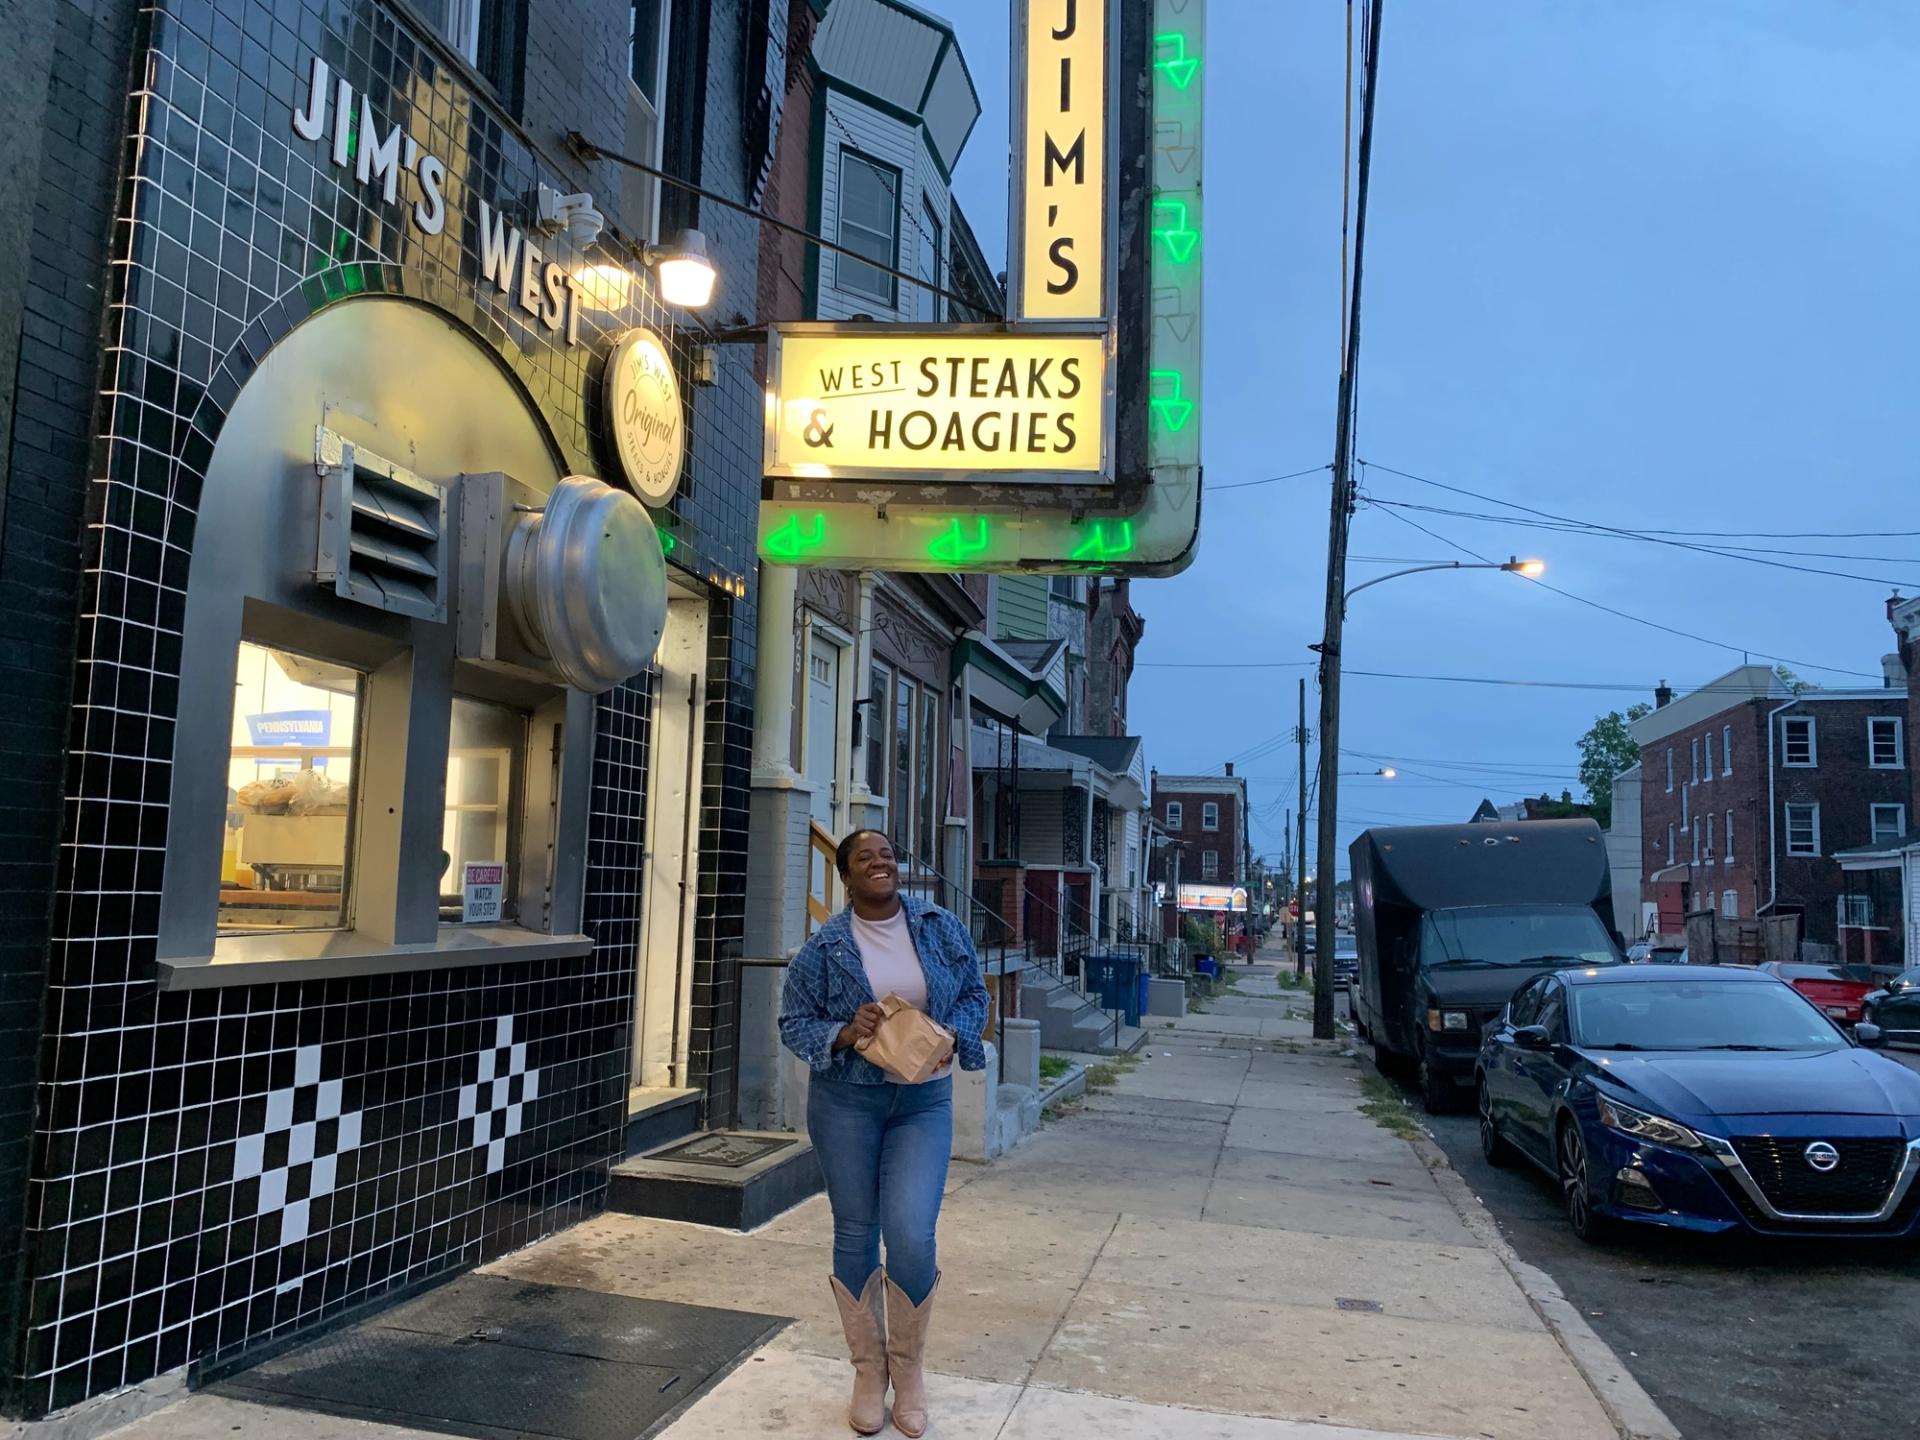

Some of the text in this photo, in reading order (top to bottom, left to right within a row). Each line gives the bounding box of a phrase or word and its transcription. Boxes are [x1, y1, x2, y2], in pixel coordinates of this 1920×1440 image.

[1044, 0, 1086, 295] JIM'S
[293, 56, 584, 347] JIM'S WEST
[630, 354, 671, 402] JIM'S WEST
[819, 356, 1081, 400] WEST STEAKS
[624, 388, 677, 447] Original
[803, 408, 1077, 454] & HOAGIES
[627, 431, 673, 485] STEAKS & HOAGIES
[256, 719, 323, 734] PENNSYLVANIA
[467, 868, 501, 883] BE CAREFUL
[474, 887, 493, 901] WATCH
[468, 902, 497, 917] YOUR STEP
